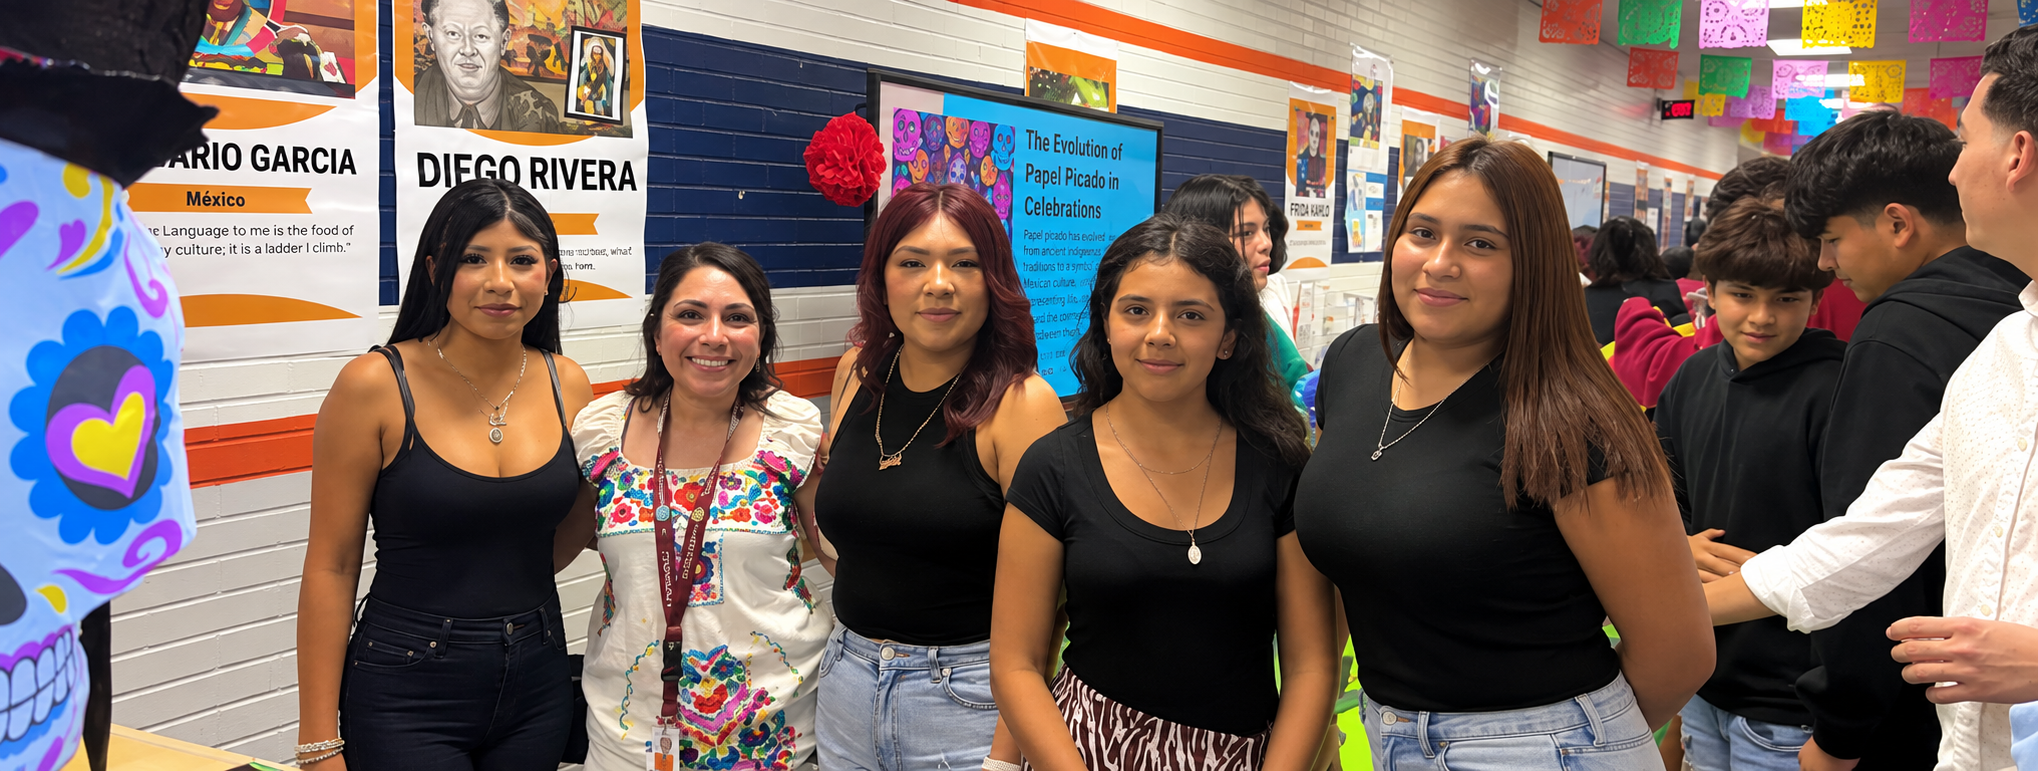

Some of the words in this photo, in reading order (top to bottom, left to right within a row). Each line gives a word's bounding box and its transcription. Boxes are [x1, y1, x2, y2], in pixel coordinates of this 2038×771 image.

[1025, 129, 1050, 152] The
[1053, 133, 1108, 159] Evolution
[1110, 143, 1123, 161] of
[158, 142, 242, 172] ARIO
[250, 144, 357, 175] GARCIA
[417, 152, 521, 188] DIEGO
[530, 157, 638, 192] RIVERA
[1025, 163, 1061, 189] Papel
[1065, 167, 1106, 189] Picado
[1108, 171, 1120, 190] in
[186, 191, 246, 207] México
[1024, 196, 1102, 219] Celebrations
[1290, 202, 1309, 217] FRIDA
[162, 225, 229, 239] Language
[233, 226, 247, 236] to
[250, 227, 271, 236] me
[273, 225, 284, 236] is
[287, 225, 308, 236] the
[311, 224, 339, 236] food
[341, 224, 355, 236] of
[1023, 229, 1043, 242] Papel
[1044, 230, 1068, 243] picado
[1068, 231, 1080, 241] has
[1081, 231, 1106, 242] evolved
[175, 244, 226, 256] culture;
[229, 243, 238, 255] it
[241, 243, 251, 255] is
[255, 245, 262, 254] a
[265, 242, 303, 254] ladder
[1023, 245, 1040, 256] from
[1041, 246, 1066, 256] ancient
[1023, 261, 1056, 272] traditions
[1057, 262, 1065, 271] to
[1023, 278, 1051, 289] Mexican
